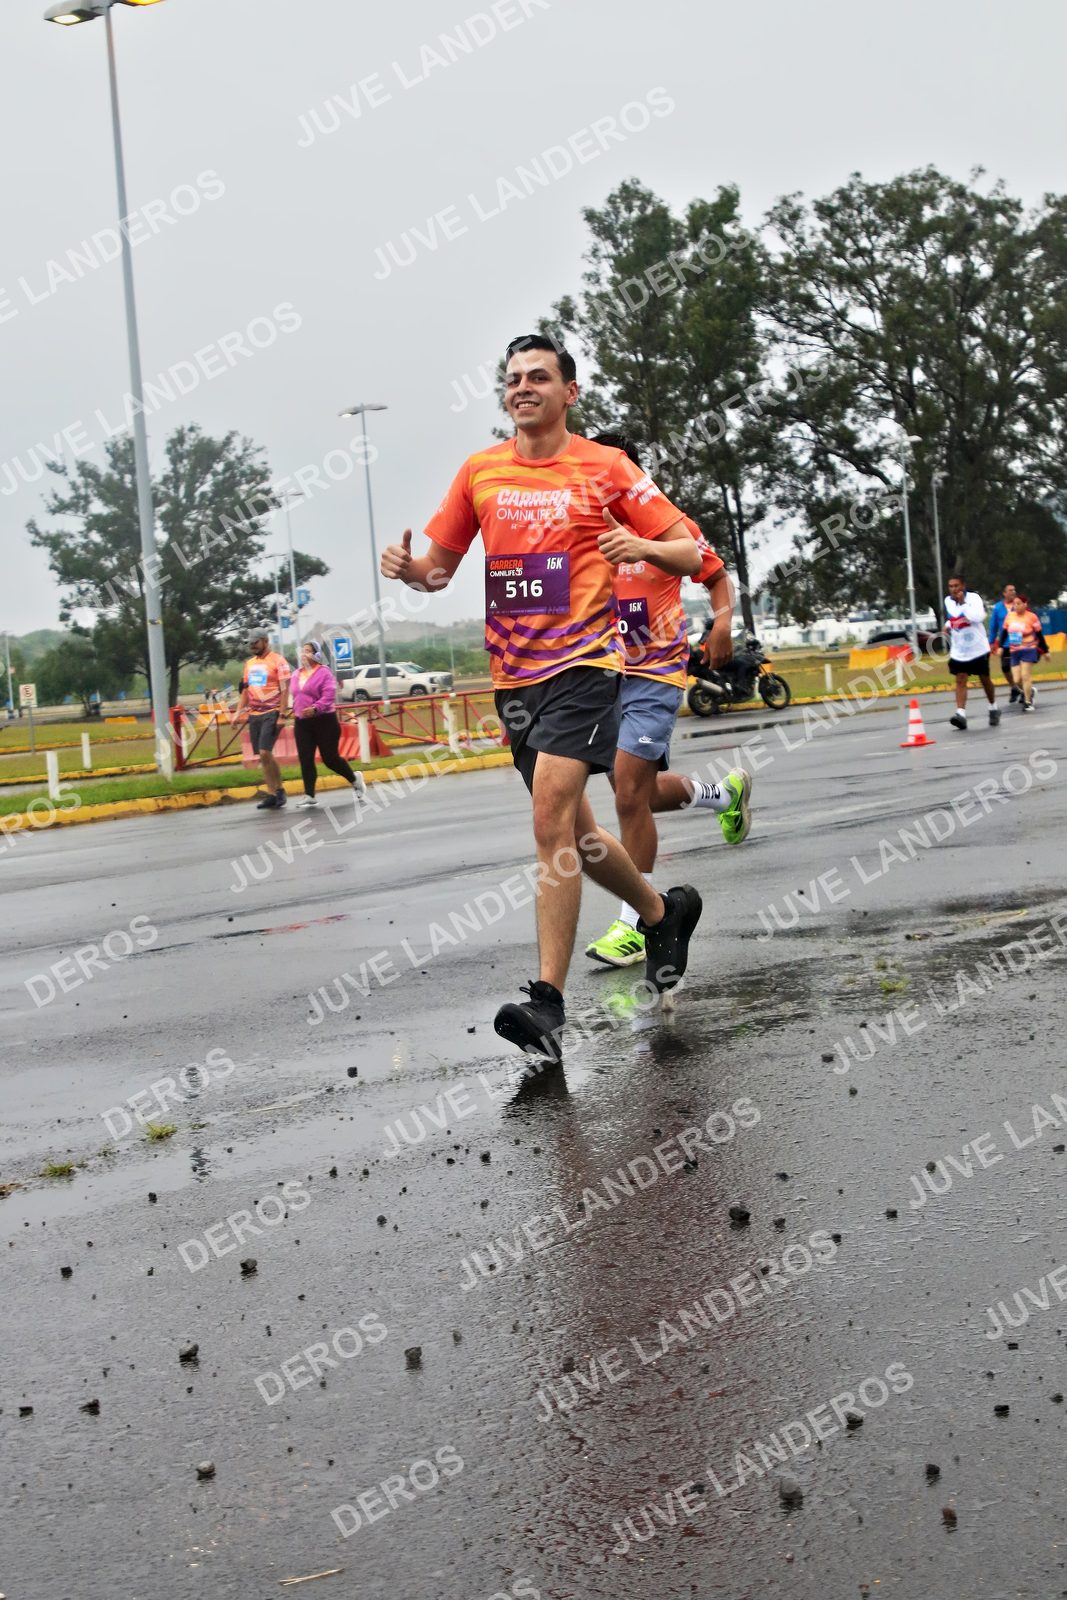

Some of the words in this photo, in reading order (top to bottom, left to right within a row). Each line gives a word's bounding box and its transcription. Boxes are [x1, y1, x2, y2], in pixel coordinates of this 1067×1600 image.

[497, 488, 571, 507] CARRERA
[490, 559, 523, 570] CARRERA
[505, 580, 543, 598] 516
